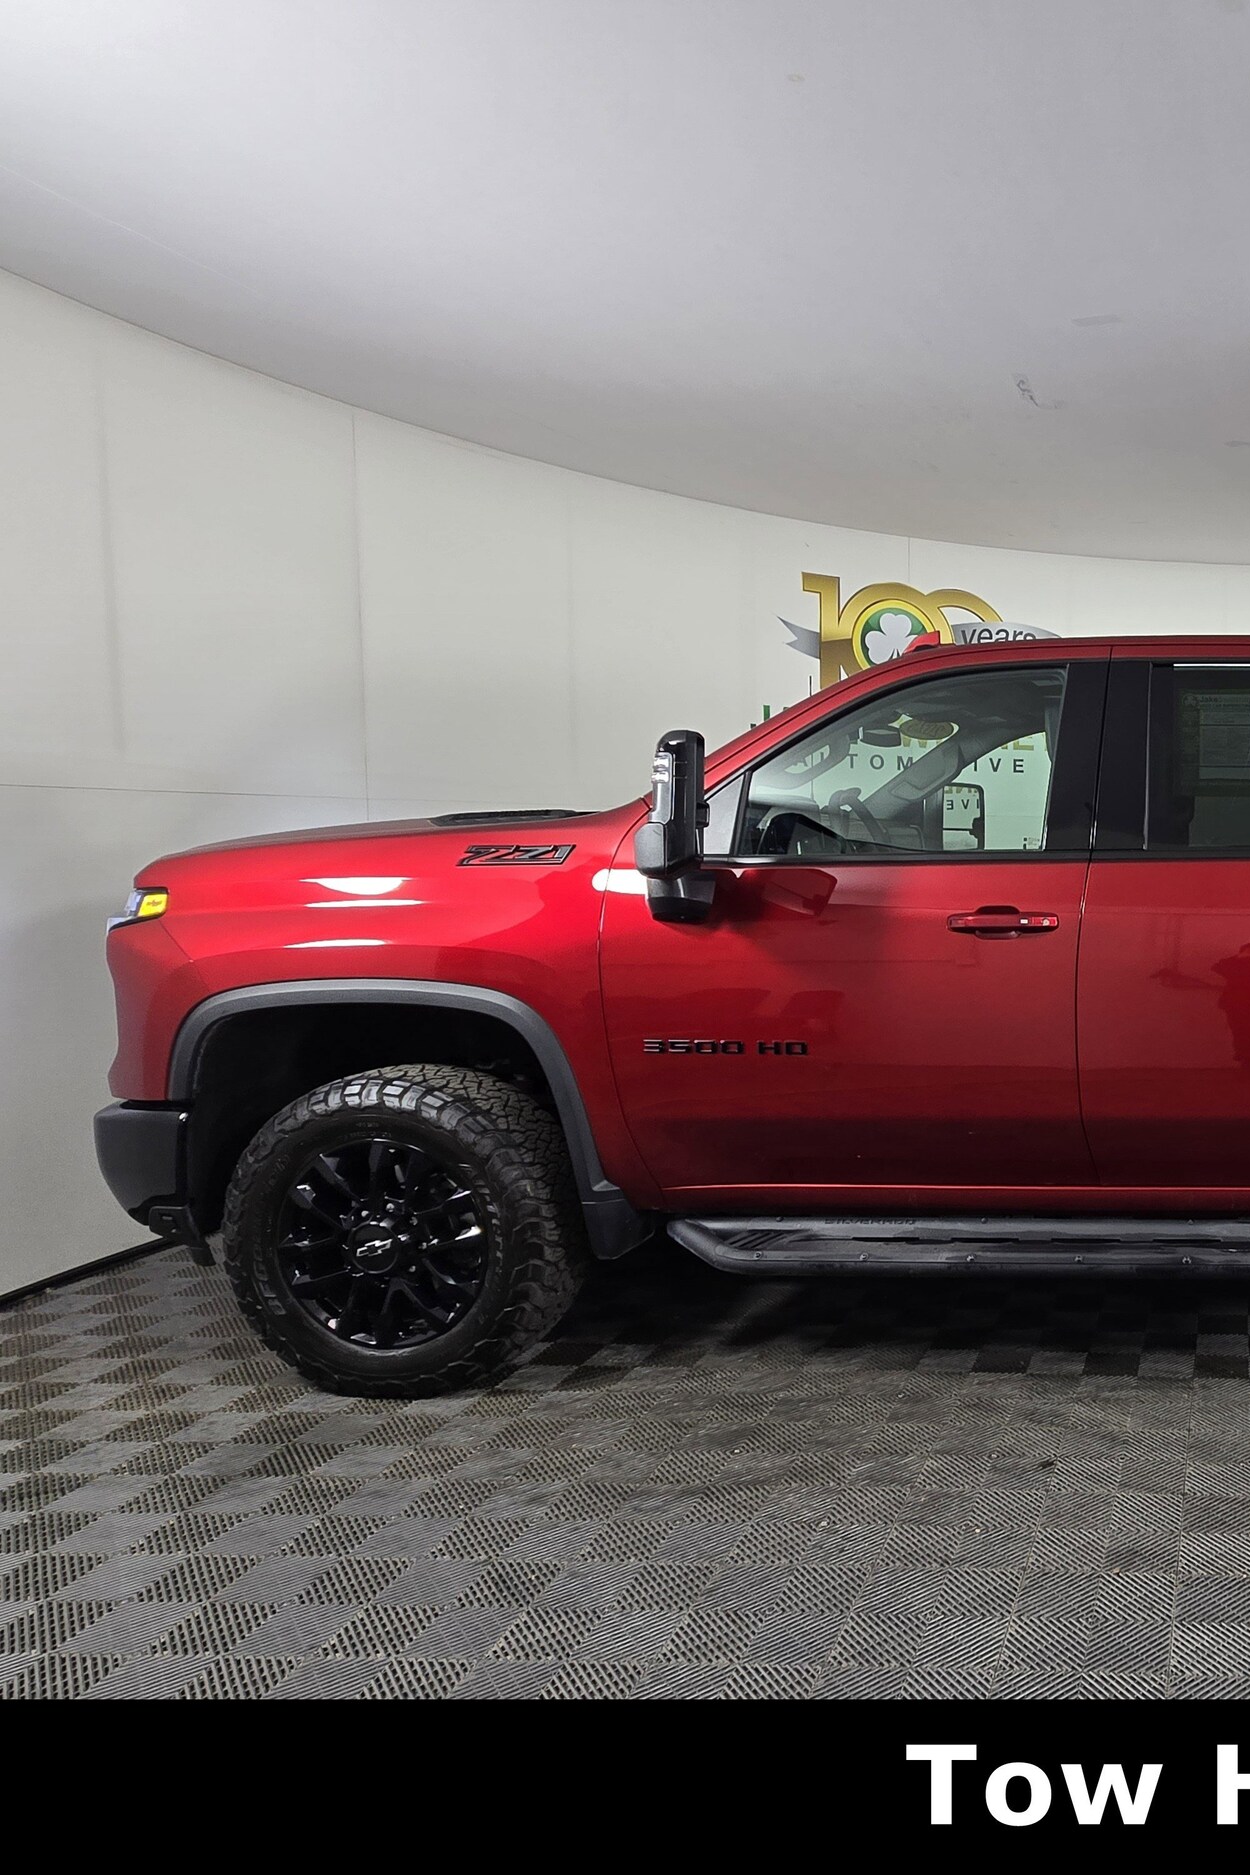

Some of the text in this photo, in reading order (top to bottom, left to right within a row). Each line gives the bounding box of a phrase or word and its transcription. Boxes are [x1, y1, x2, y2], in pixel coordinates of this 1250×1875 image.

[456, 844, 577, 866] Z71
[643, 1039, 809, 1056] 3500 HD
